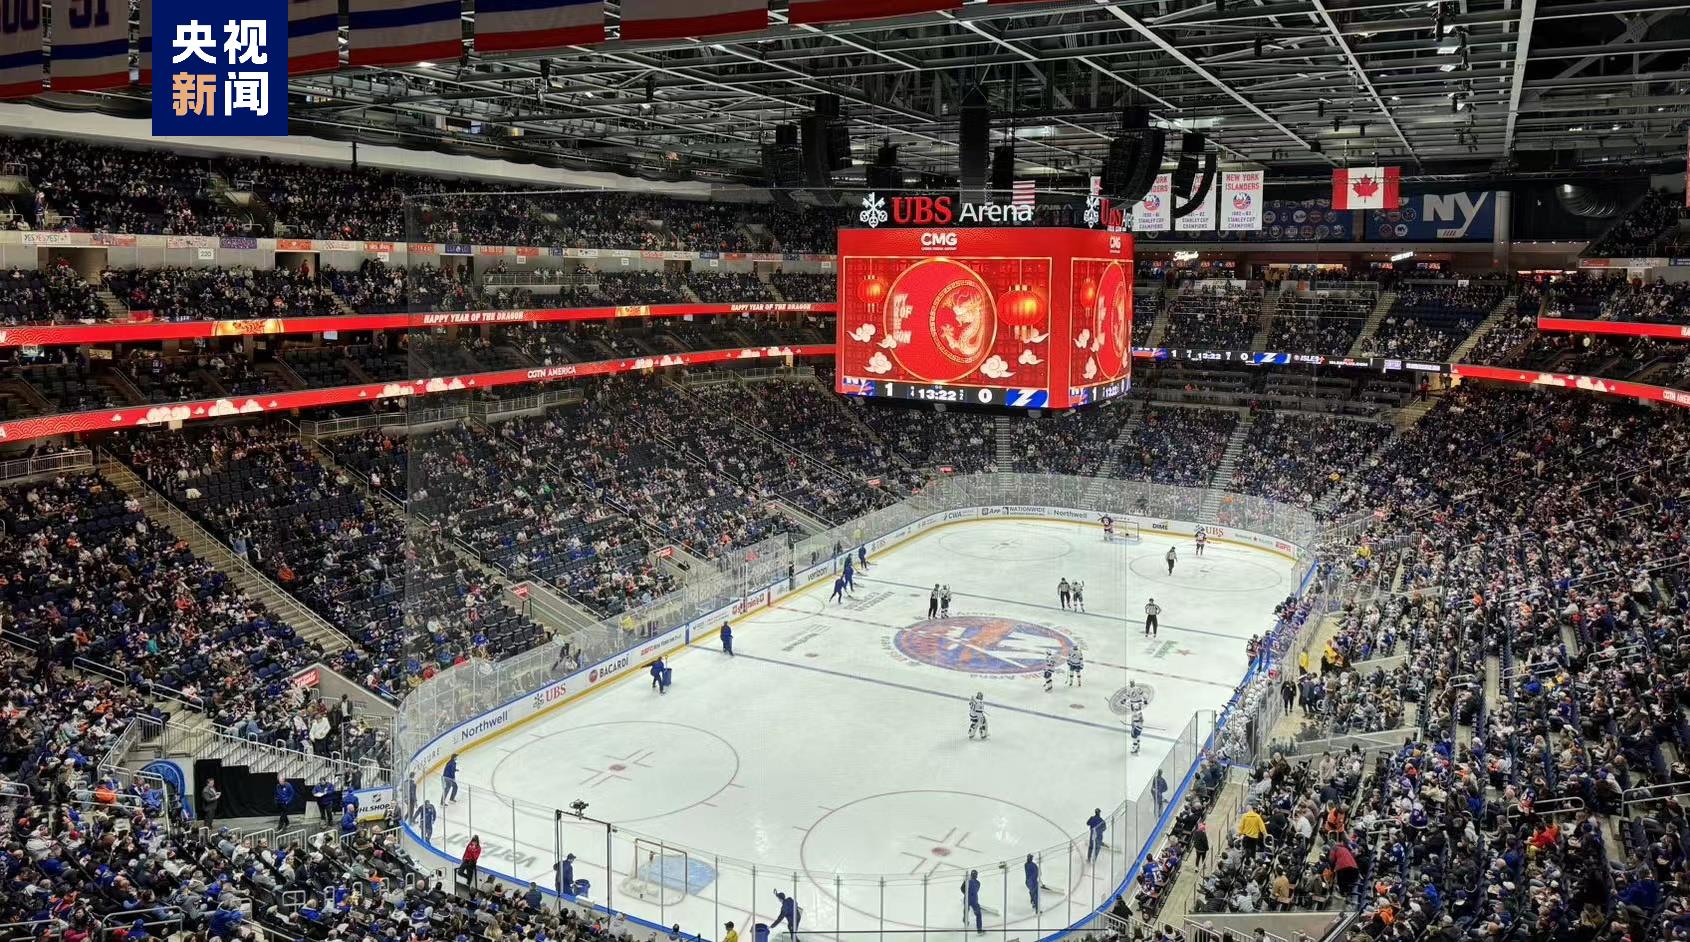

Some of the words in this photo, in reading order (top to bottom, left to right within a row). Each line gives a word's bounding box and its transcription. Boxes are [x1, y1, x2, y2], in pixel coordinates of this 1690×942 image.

[891, 196, 953, 225] UBS
[959, 202, 1034, 222] Arena
[921, 232, 958, 246] CMG
[423, 314, 449, 323] HAPPY
[450, 313, 470, 322] YEAR
[471, 313, 480, 321] OF
[482, 312, 496, 321] THE
[497, 311, 524, 320] DRAGON
[527, 369, 546, 379] CGTN
[547, 366, 577, 377] AMERICA
[885, 383, 893, 397] 1
[918, 388, 956, 401] 13:22
[978, 388, 992, 403] 0
[545, 683, 566, 702] UBS
[461, 710, 508, 741] Northwell
